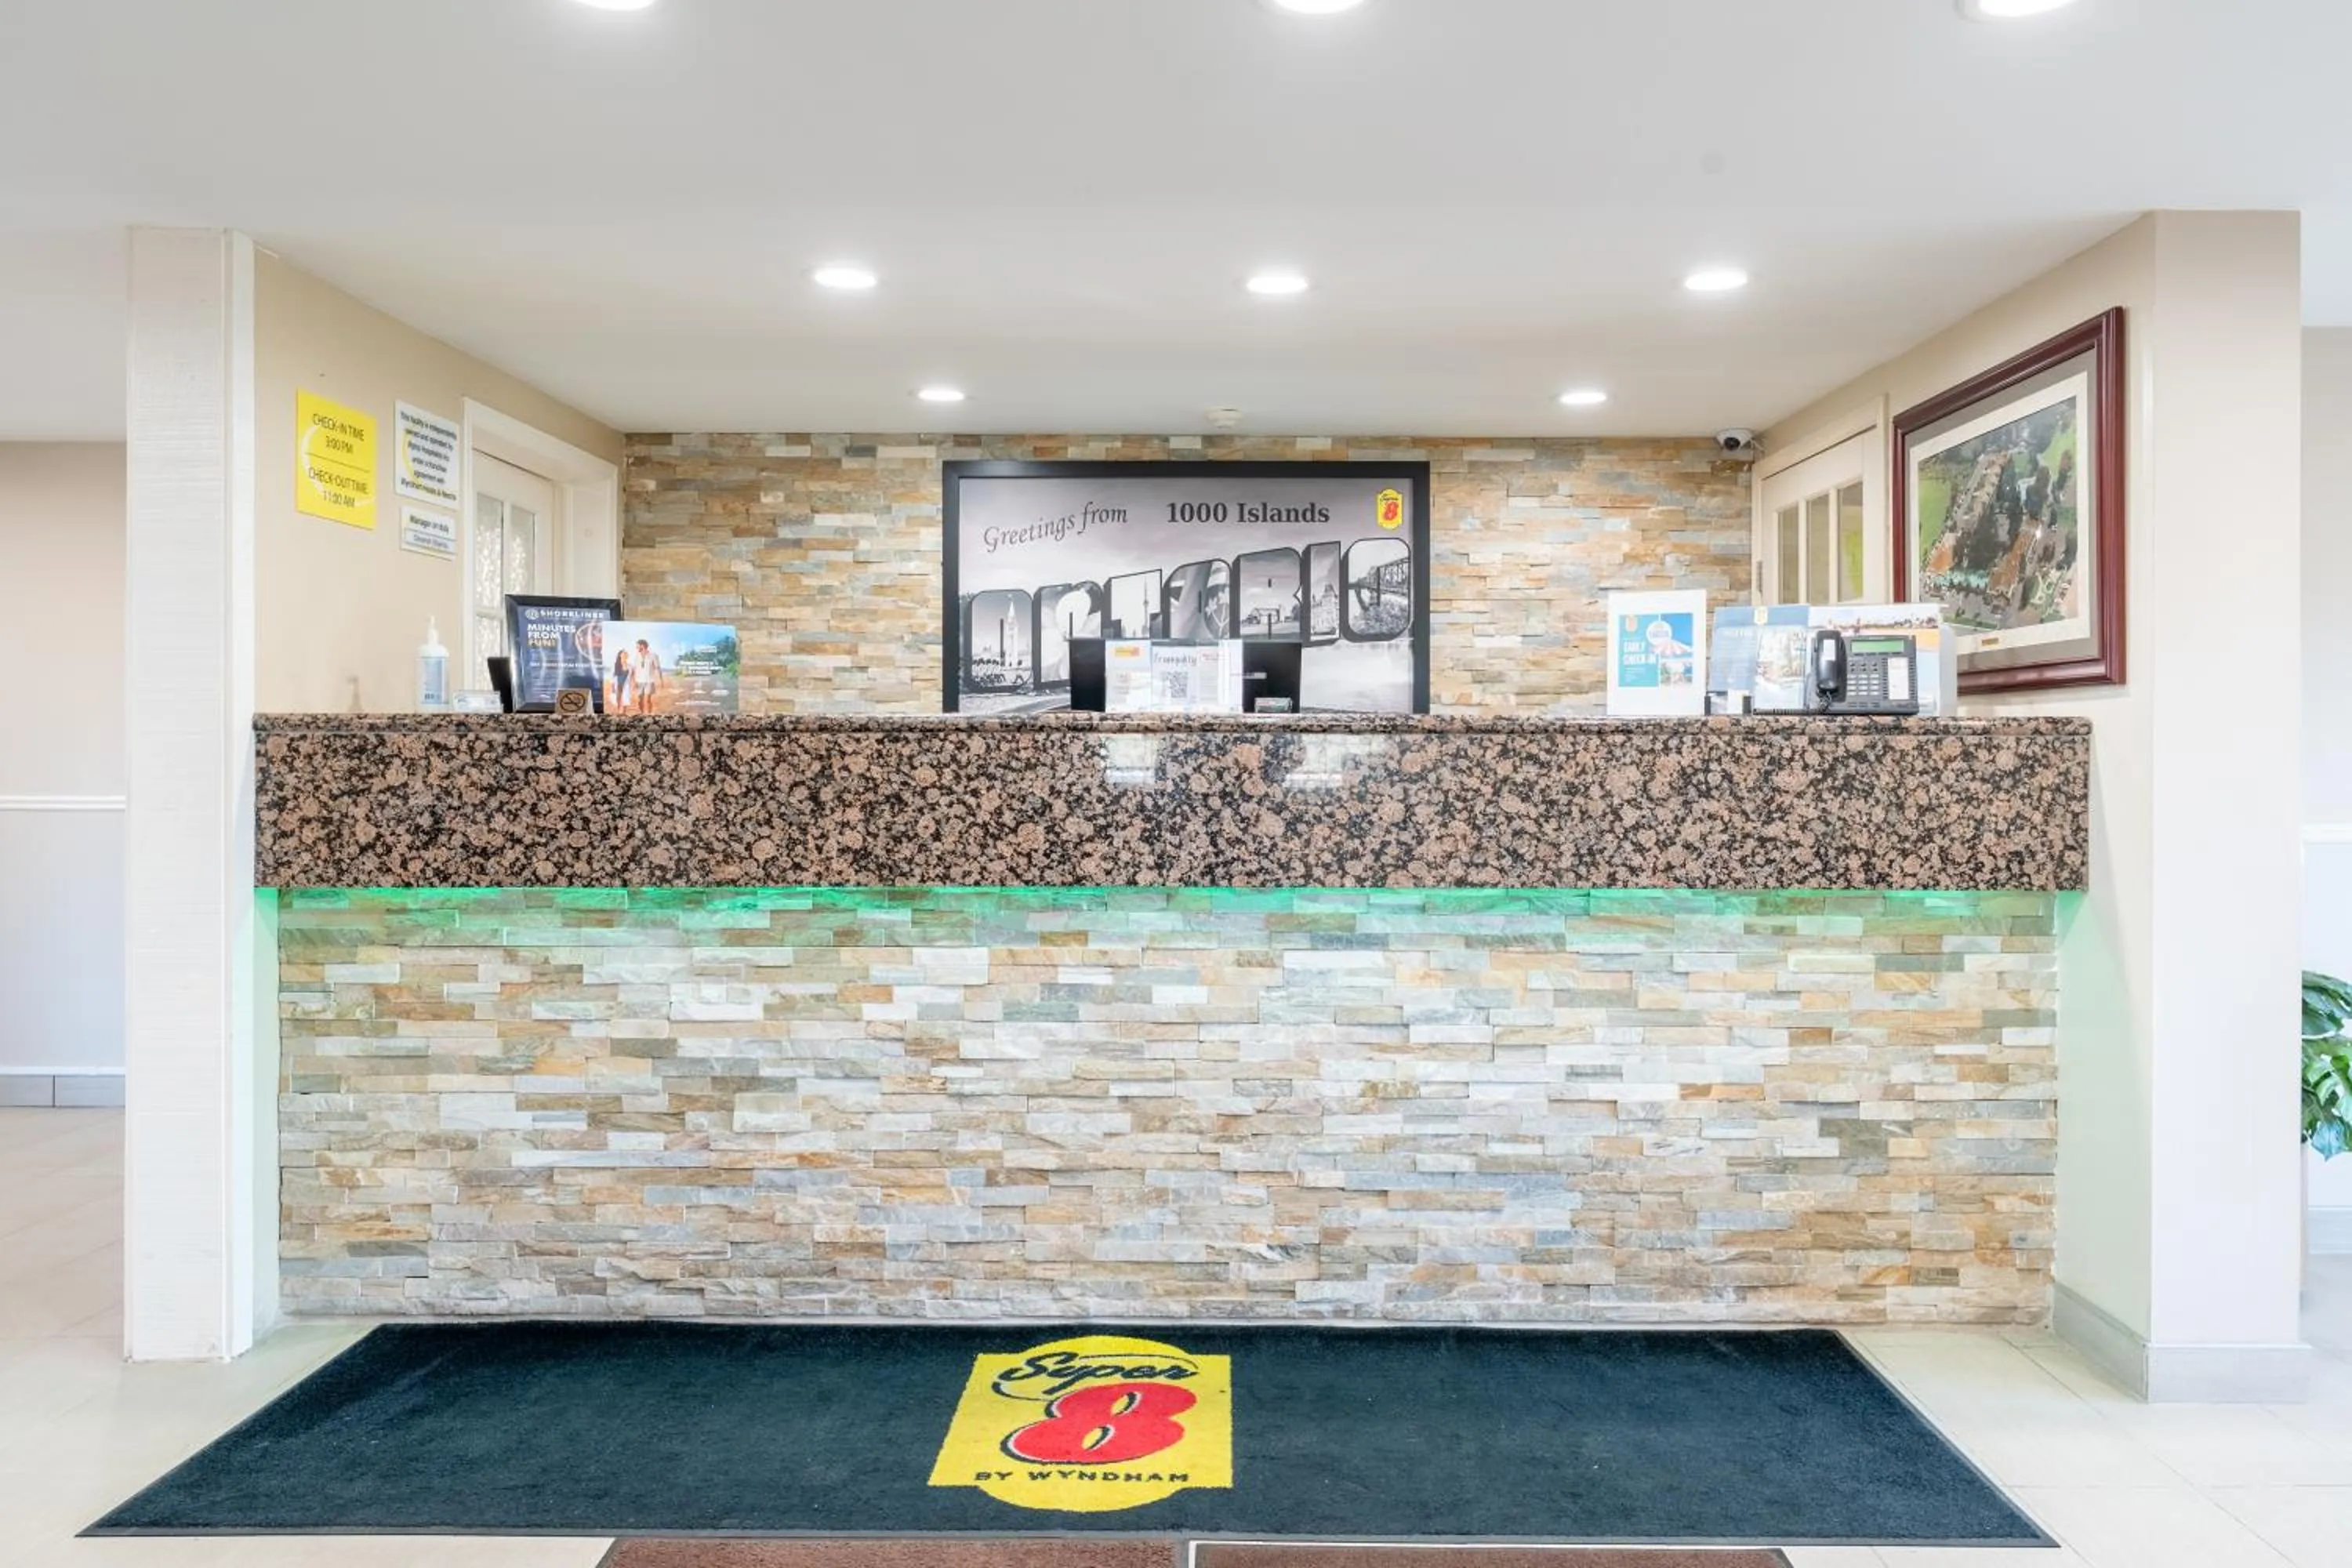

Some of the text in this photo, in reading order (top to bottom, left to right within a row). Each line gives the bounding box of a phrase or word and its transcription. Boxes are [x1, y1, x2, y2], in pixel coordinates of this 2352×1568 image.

[313, 413, 365, 441] CHECK-IN TIME
[342, 440, 354, 454] PM
[308, 466, 350, 489] CHECK-OUT
[1167, 502, 1330, 523] 1000 Islands
[984, 501, 1128, 553] Greetings from
[527, 623, 576, 633] MINUTES
[992, 1352, 1200, 1402] Super
[1000, 1382, 1198, 1465] 8
[975, 1470, 1190, 1483] BY WYNDHAM
